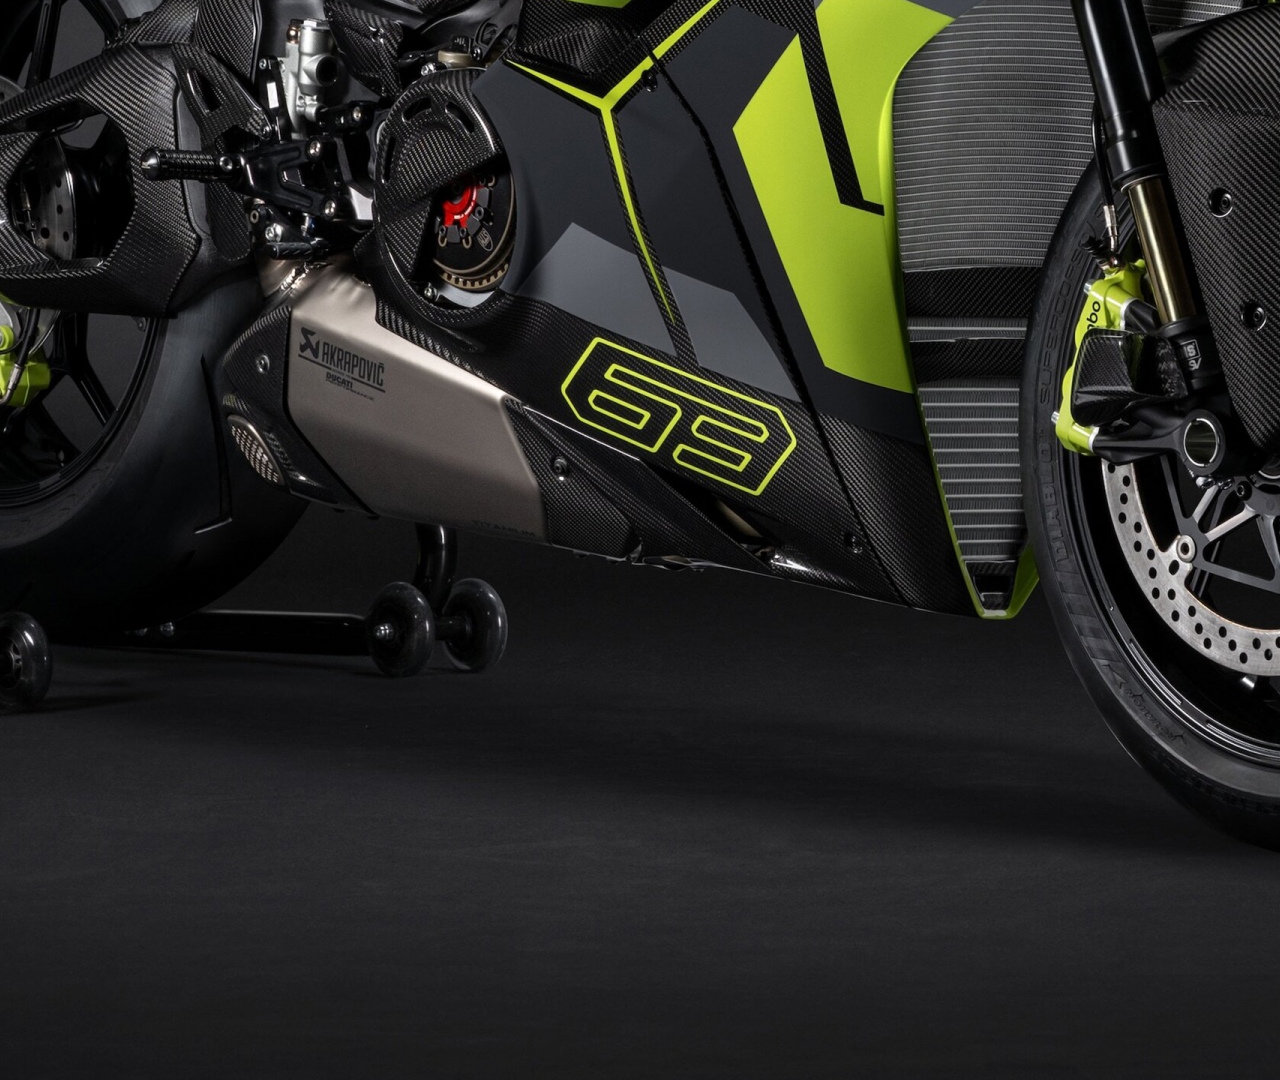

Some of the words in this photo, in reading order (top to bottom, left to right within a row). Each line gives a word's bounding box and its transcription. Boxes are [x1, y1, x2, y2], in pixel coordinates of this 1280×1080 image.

[321, 341, 385, 387] AKRAPOVIČ
[1039, 246, 1084, 405] SUPERCORS
[326, 371, 353, 389] DUCATI
[561, 336, 797, 496] 63
